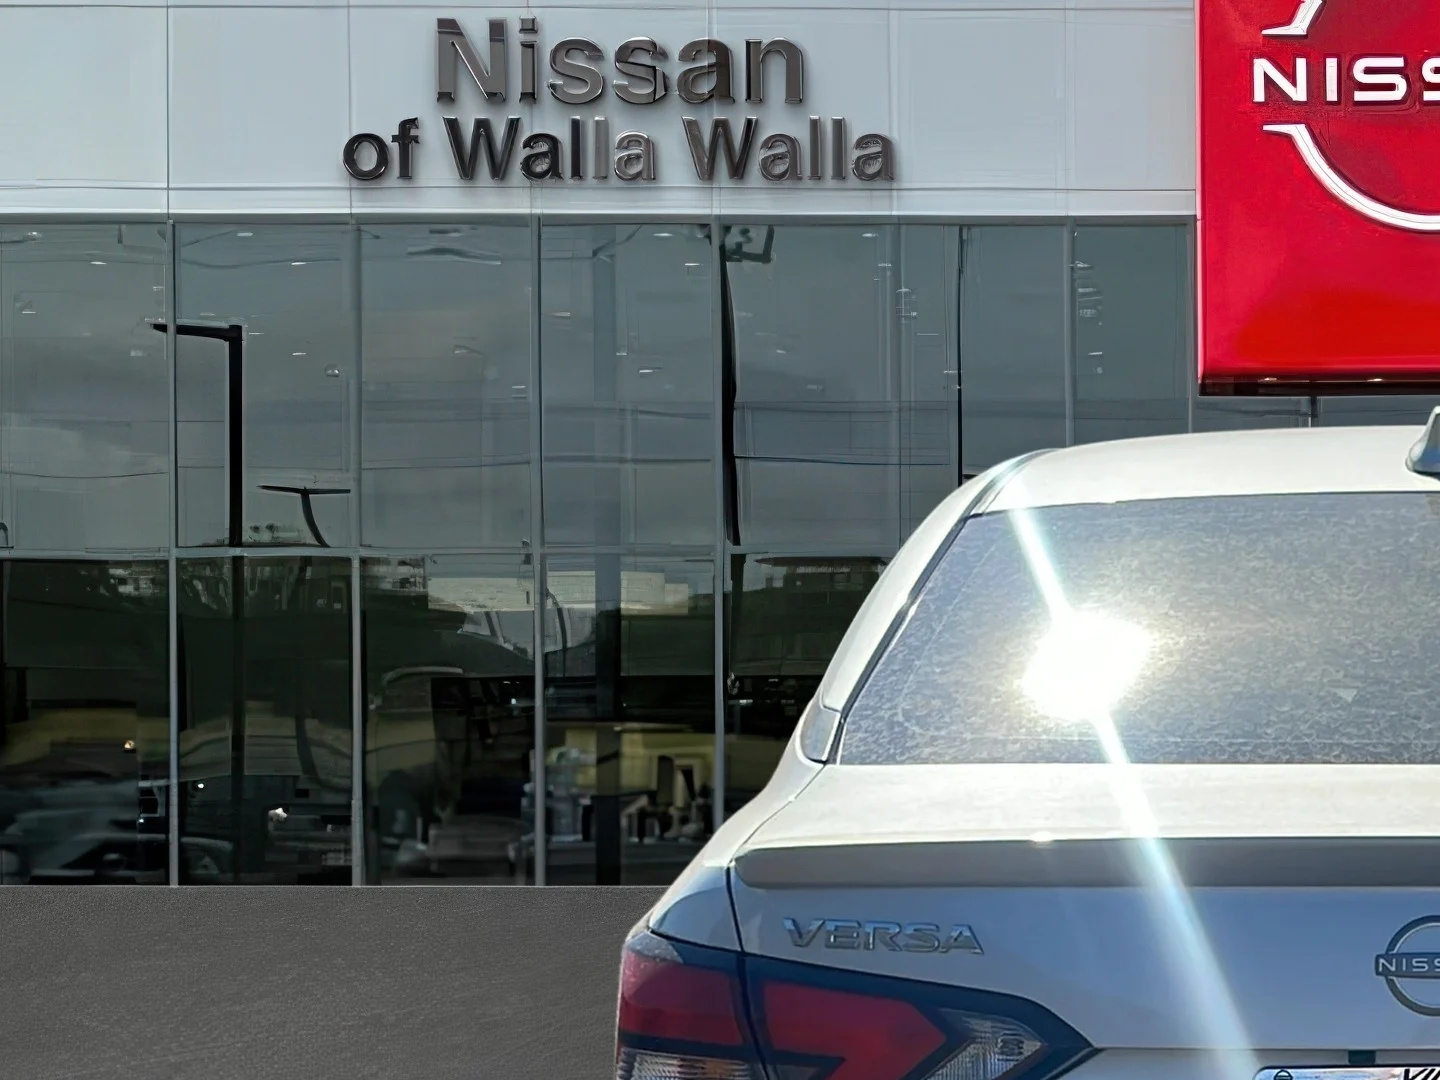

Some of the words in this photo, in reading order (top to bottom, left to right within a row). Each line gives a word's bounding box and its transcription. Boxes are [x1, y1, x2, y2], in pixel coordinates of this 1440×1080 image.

[436, 17, 804, 104] Nissan
[342, 117, 420, 180] of
[442, 115, 656, 180] Walla
[681, 115, 894, 181] Walla
[782, 917, 985, 955] VERSA
